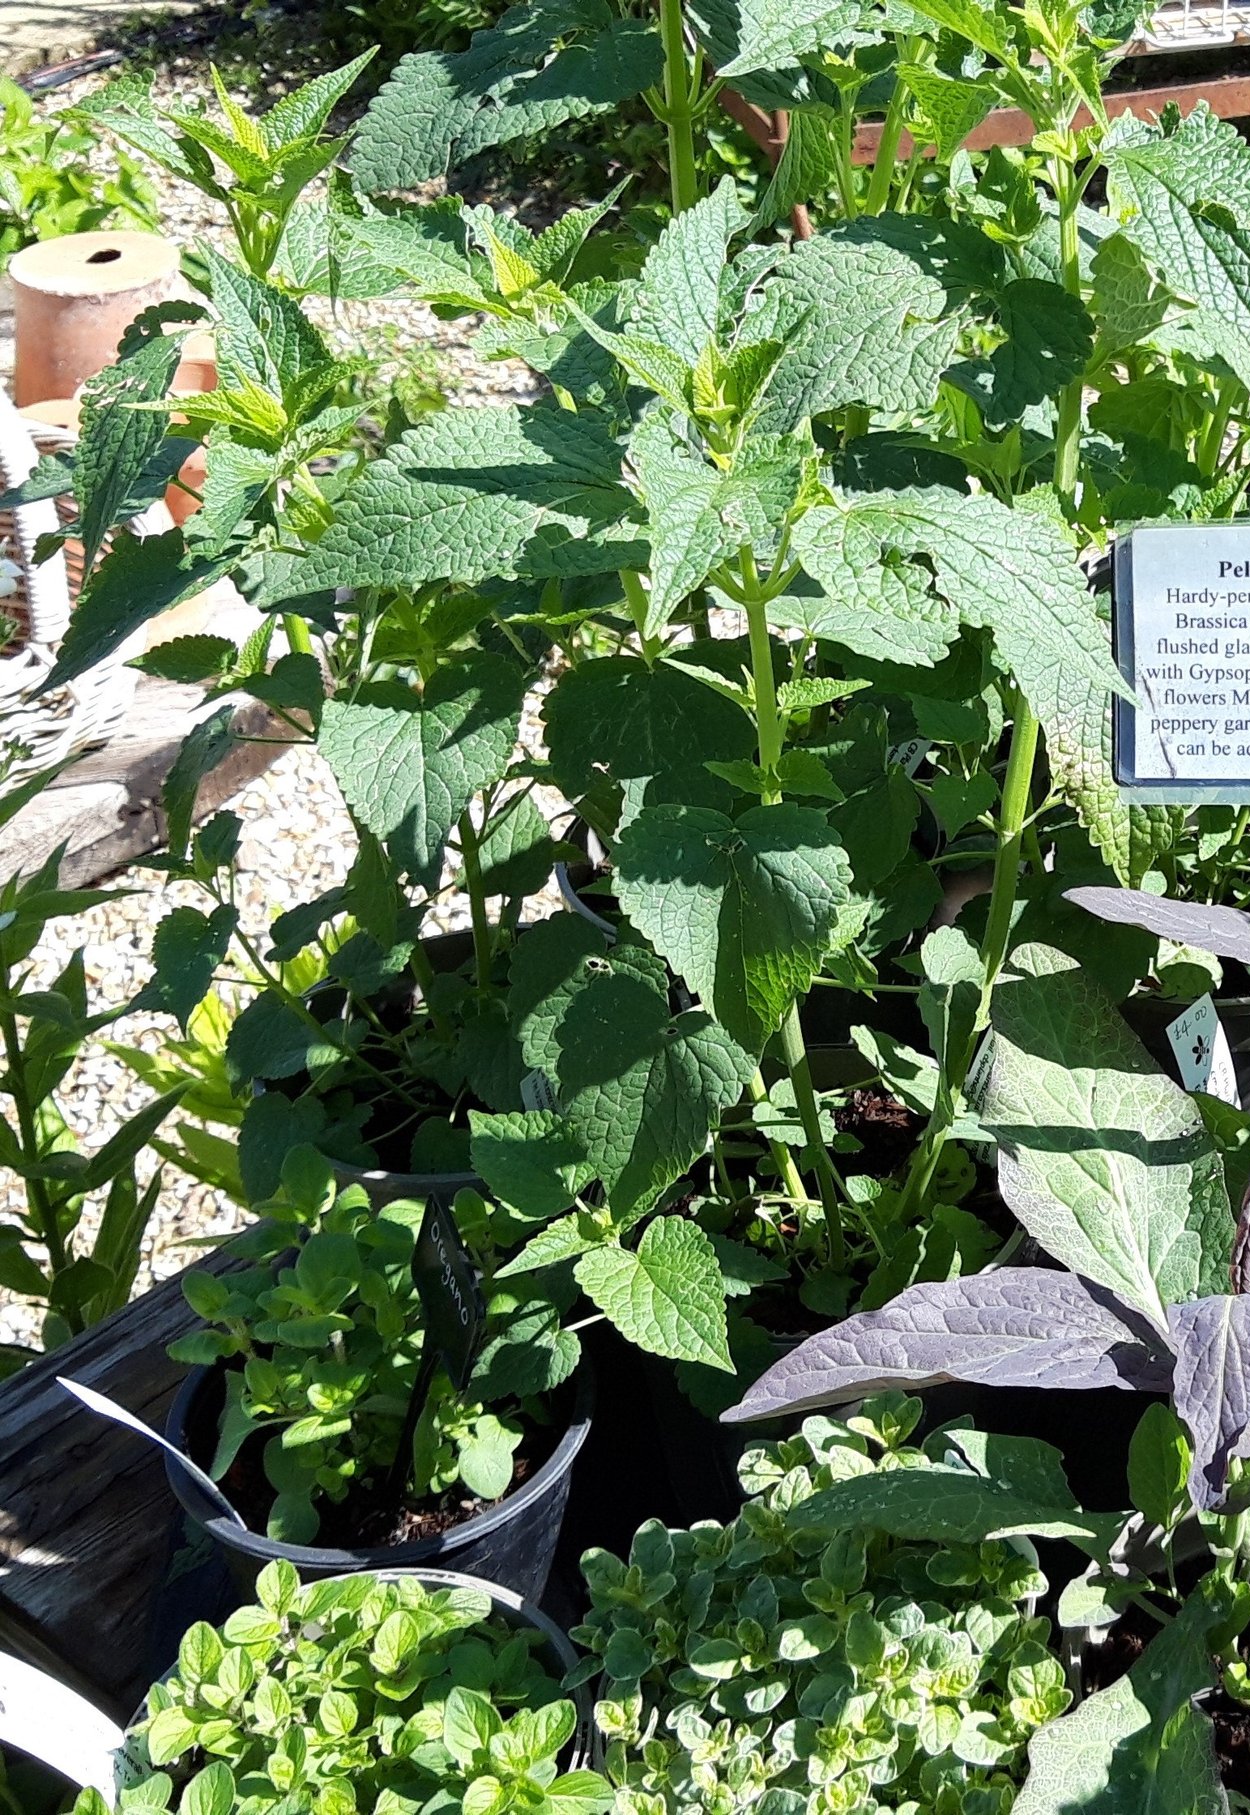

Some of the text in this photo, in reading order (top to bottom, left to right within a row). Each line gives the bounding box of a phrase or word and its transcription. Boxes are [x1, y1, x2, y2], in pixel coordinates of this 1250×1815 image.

[1175, 612, 1248, 630] Brassica
[1156, 637, 1219, 655] flushed
[1146, 663, 1183, 681] with
[1164, 688, 1227, 707] flowers
[1150, 717, 1218, 736] peppery
[1176, 742, 1206, 757] can
[1211, 739, 1232, 757] be
[430, 1220, 469, 1326] Oregano
